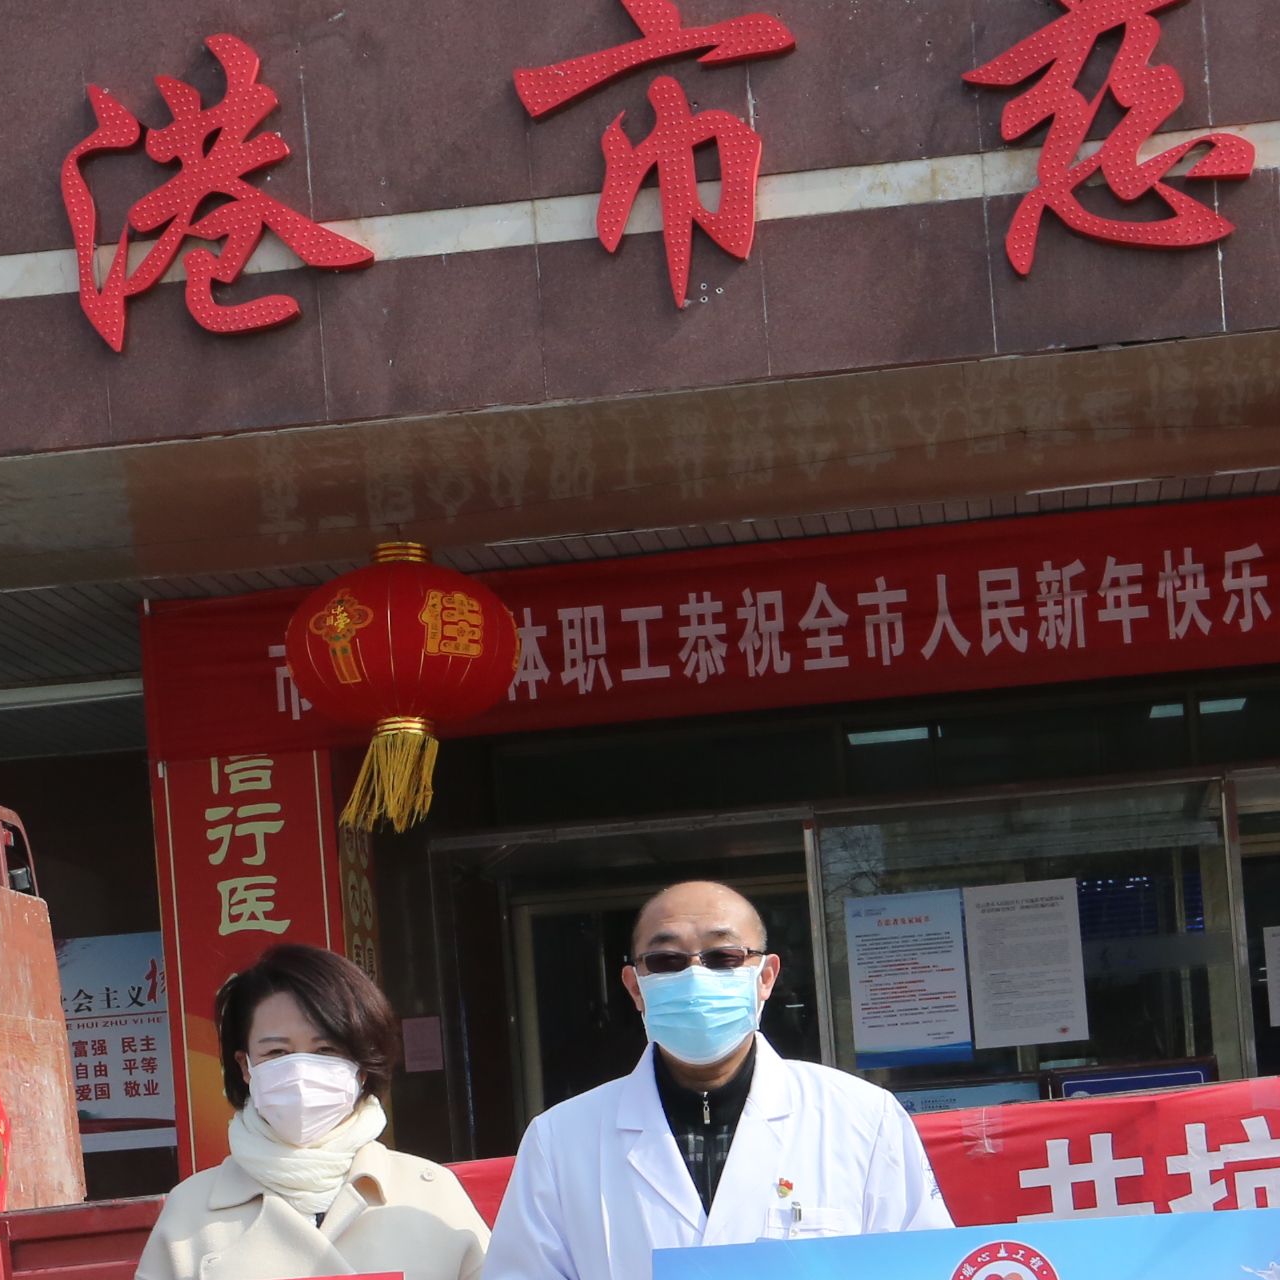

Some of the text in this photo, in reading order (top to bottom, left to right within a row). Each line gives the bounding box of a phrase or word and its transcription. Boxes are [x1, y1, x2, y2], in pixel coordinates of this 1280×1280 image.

[77, 1021, 99, 1029] HUI
[102, 1019, 128, 1028] ZHU
[148, 1016, 163, 1024] HE
[72, 1035, 157, 1058] 富强 民主
[75, 1056, 158, 1080] 自由 平等
[75, 1079, 160, 1102] 爱国 敬业
